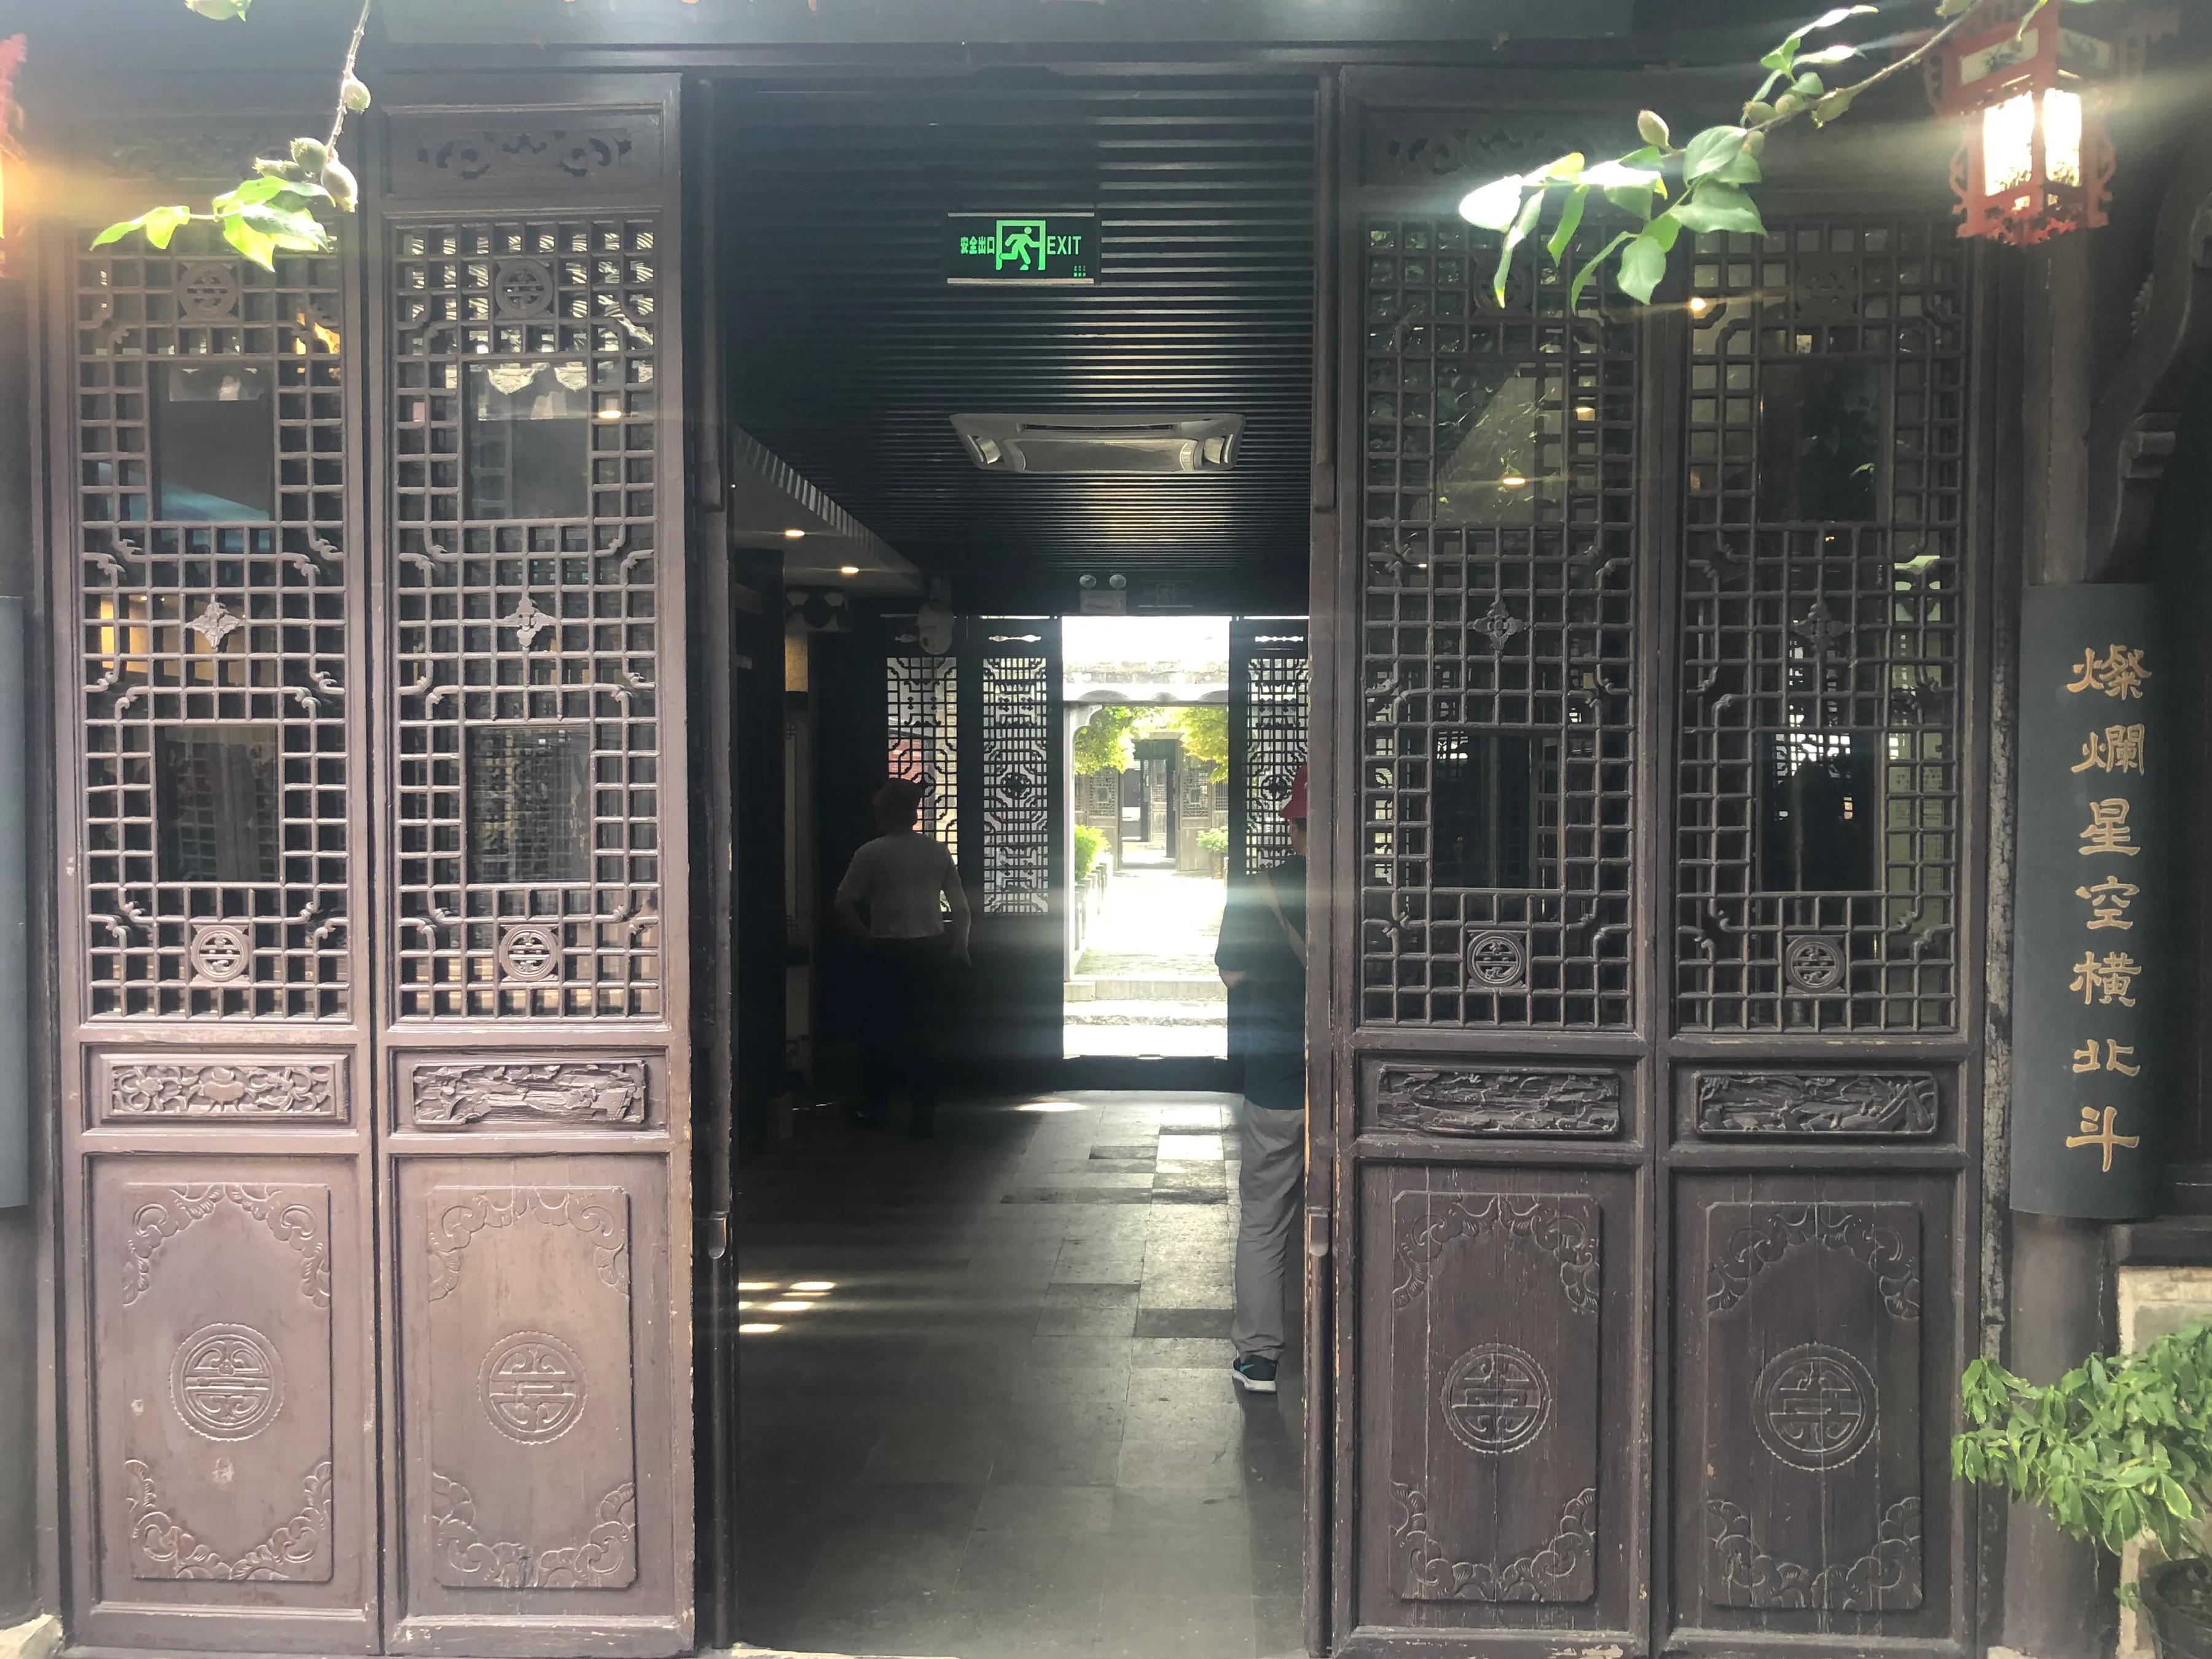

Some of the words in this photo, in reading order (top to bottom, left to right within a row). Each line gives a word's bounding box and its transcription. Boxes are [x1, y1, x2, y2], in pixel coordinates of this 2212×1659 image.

[960, 236, 995, 254] 安全出口
[1047, 236, 1081, 254] EXIT
